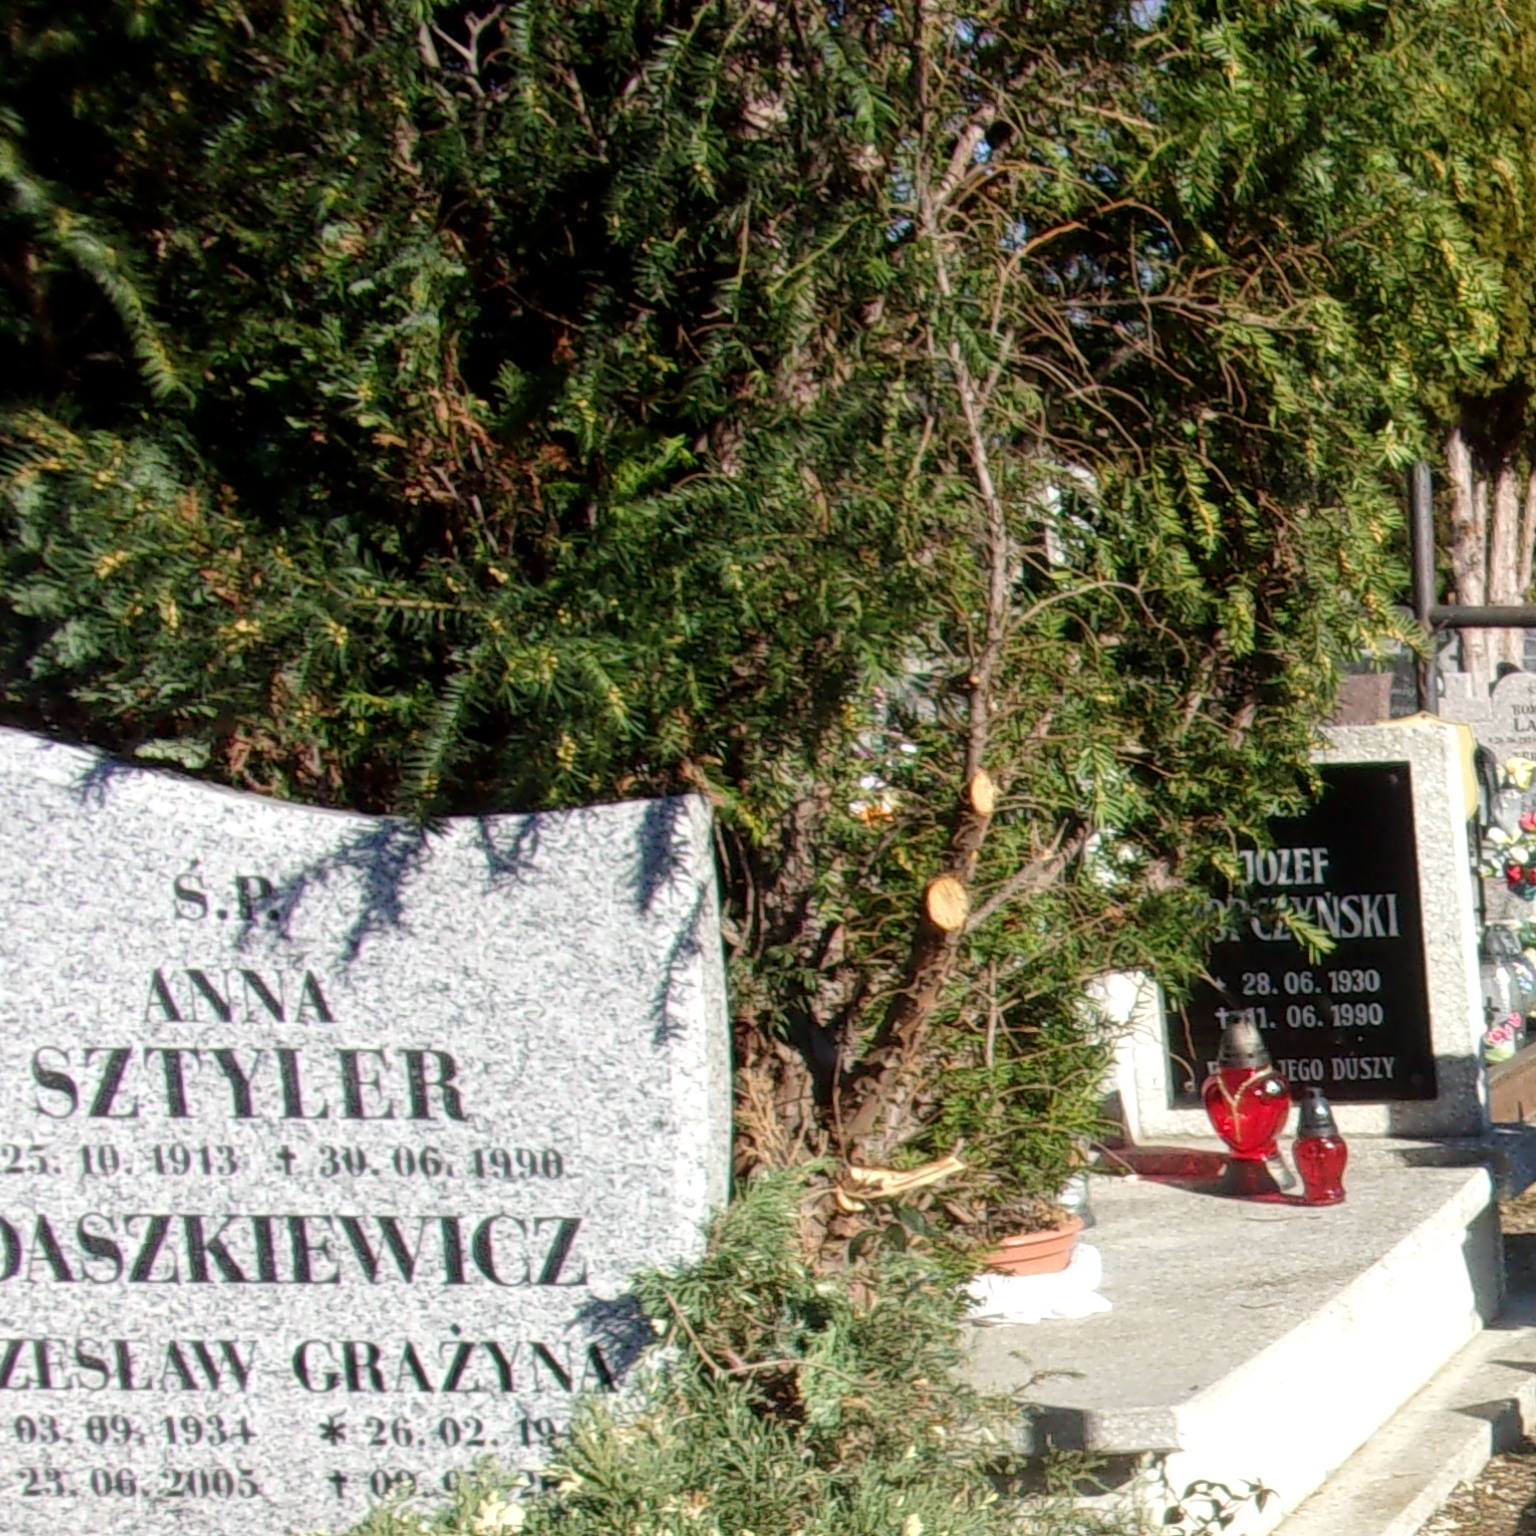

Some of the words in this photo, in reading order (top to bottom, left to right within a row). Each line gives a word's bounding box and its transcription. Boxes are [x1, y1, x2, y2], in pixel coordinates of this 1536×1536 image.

[143, 967, 340, 1024] ANNA
[1283, 970, 1322, 995] 06.
[1328, 968, 1382, 994] 1930
[1286, 1004, 1324, 1029] 06.
[1330, 1002, 1385, 1028] 1990
[30, 1044, 470, 1123] SZTYLER
[1332, 1055, 1396, 1081] DUSZY
[292, 1323, 621, 1394] GRAŻYNA
[514, 1415, 572, 1449] 19
[158, 1465, 261, 1499] 2005
